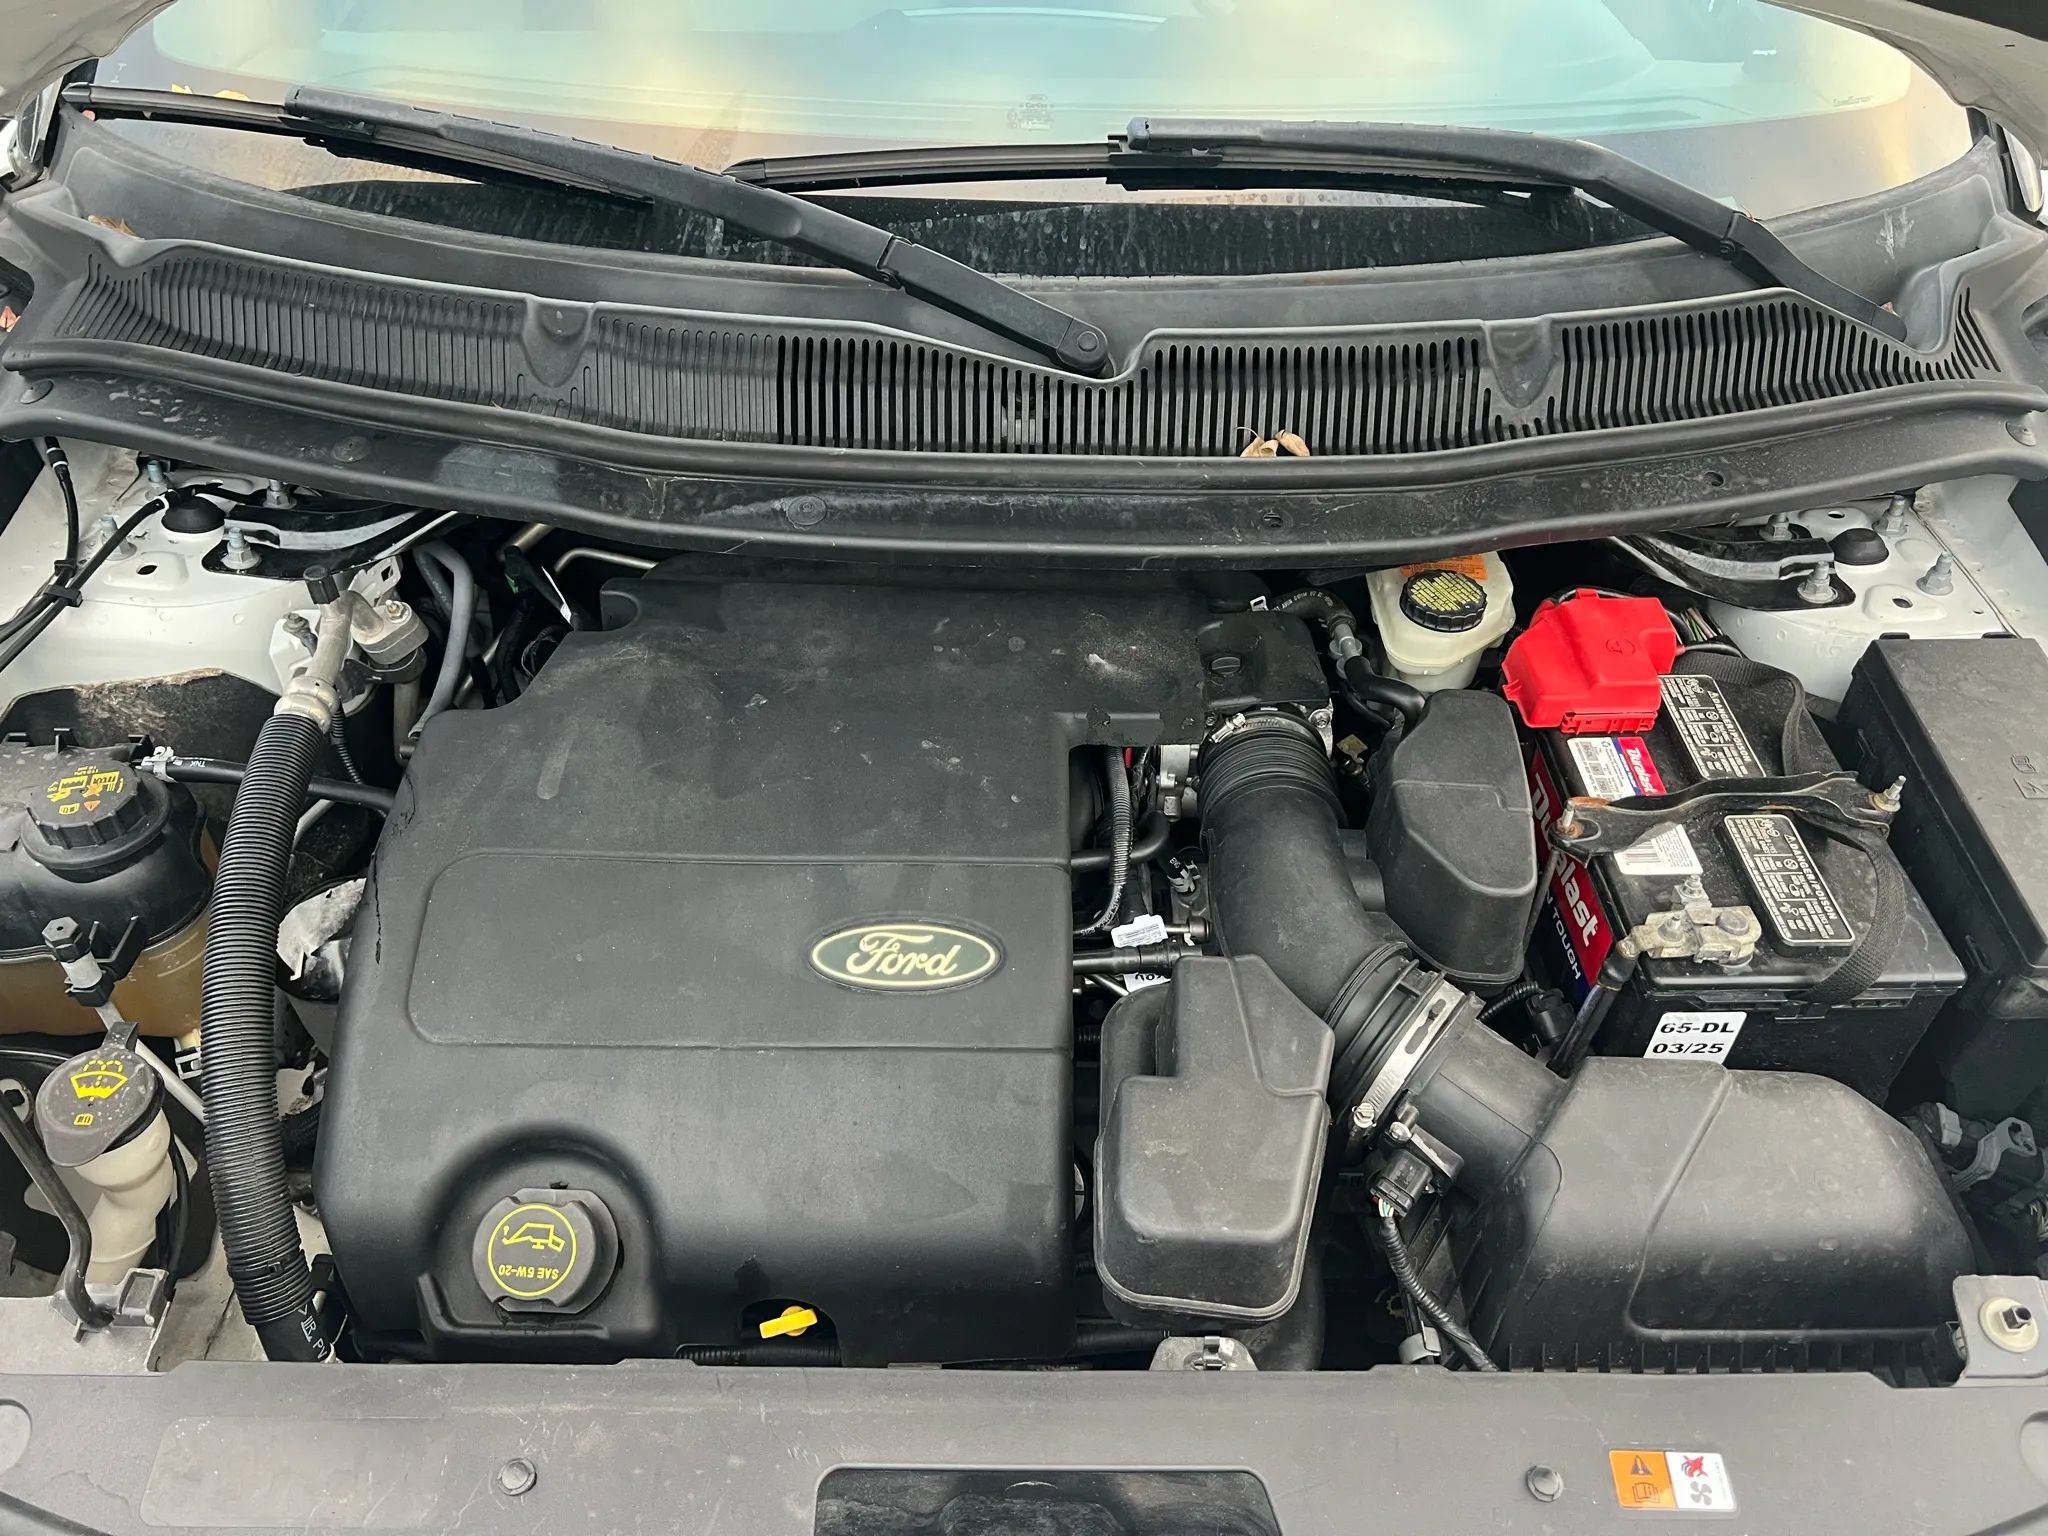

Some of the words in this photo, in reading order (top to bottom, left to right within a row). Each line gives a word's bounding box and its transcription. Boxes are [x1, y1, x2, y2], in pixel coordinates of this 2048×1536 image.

[1711, 698, 1752, 761] DANGER/POISON
[1626, 747, 1658, 793] Duralast
[1790, 840, 1837, 919] DANGER/POISON
[846, 932, 961, 976] Ford
[1552, 906, 1581, 980] TOUGH
[1652, 1043, 1725, 1054] 03/25
[1660, 1022, 1735, 1034] 65-DL
[498, 1264, 535, 1279] 5W-20
[537, 1267, 559, 1280] SAE
